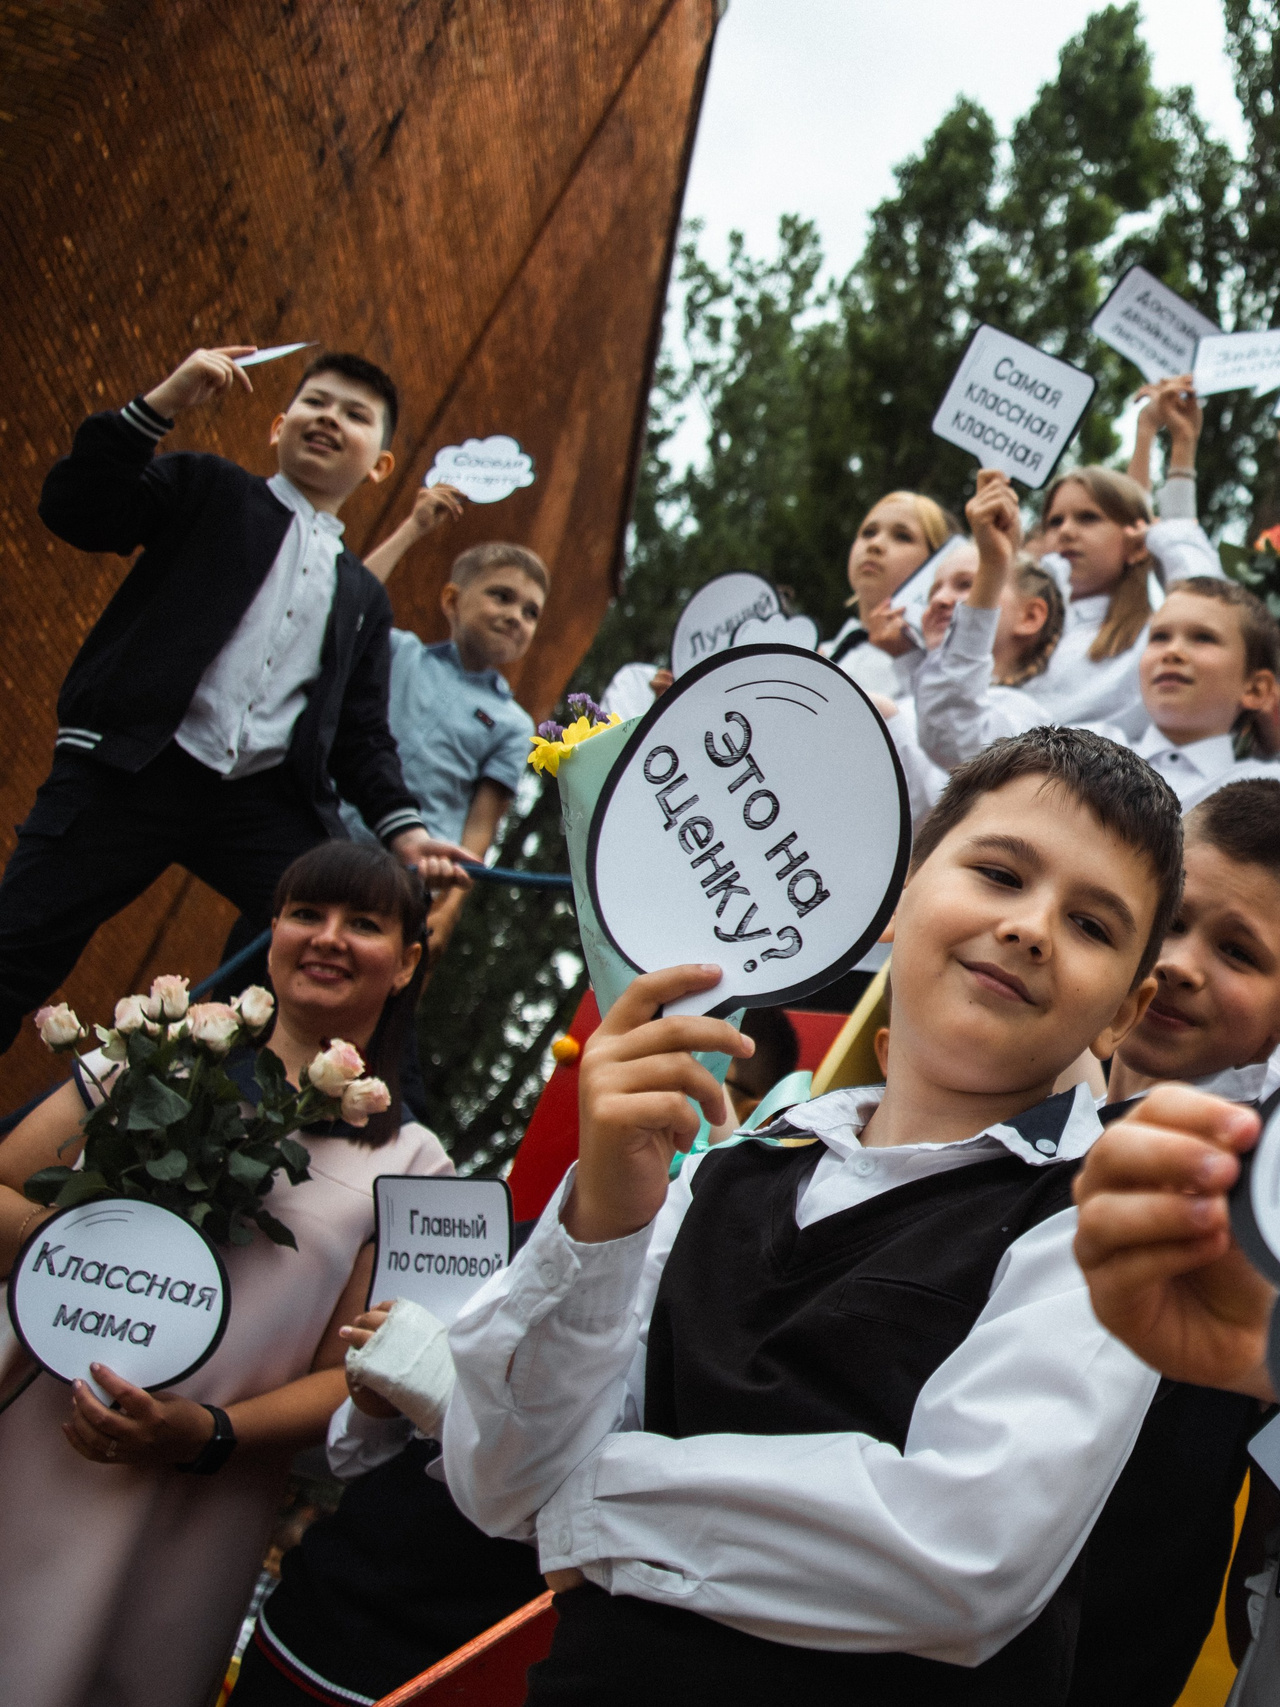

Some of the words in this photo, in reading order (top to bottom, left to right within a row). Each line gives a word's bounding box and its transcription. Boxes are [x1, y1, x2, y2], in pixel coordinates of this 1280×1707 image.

[964, 382, 1060, 442] классная
[994, 357, 1063, 408] Самая
[952, 410, 1044, 471] классная
[704, 711, 780, 831] Это
[764, 830, 831, 918] на
[643, 744, 803, 973] оценку?
[409, 1209, 487, 1240] Главный
[32, 1241, 218, 1312] Классная
[388, 1251, 410, 1272] по
[414, 1253, 503, 1278] столовой
[52, 1303, 157, 1347] мама
